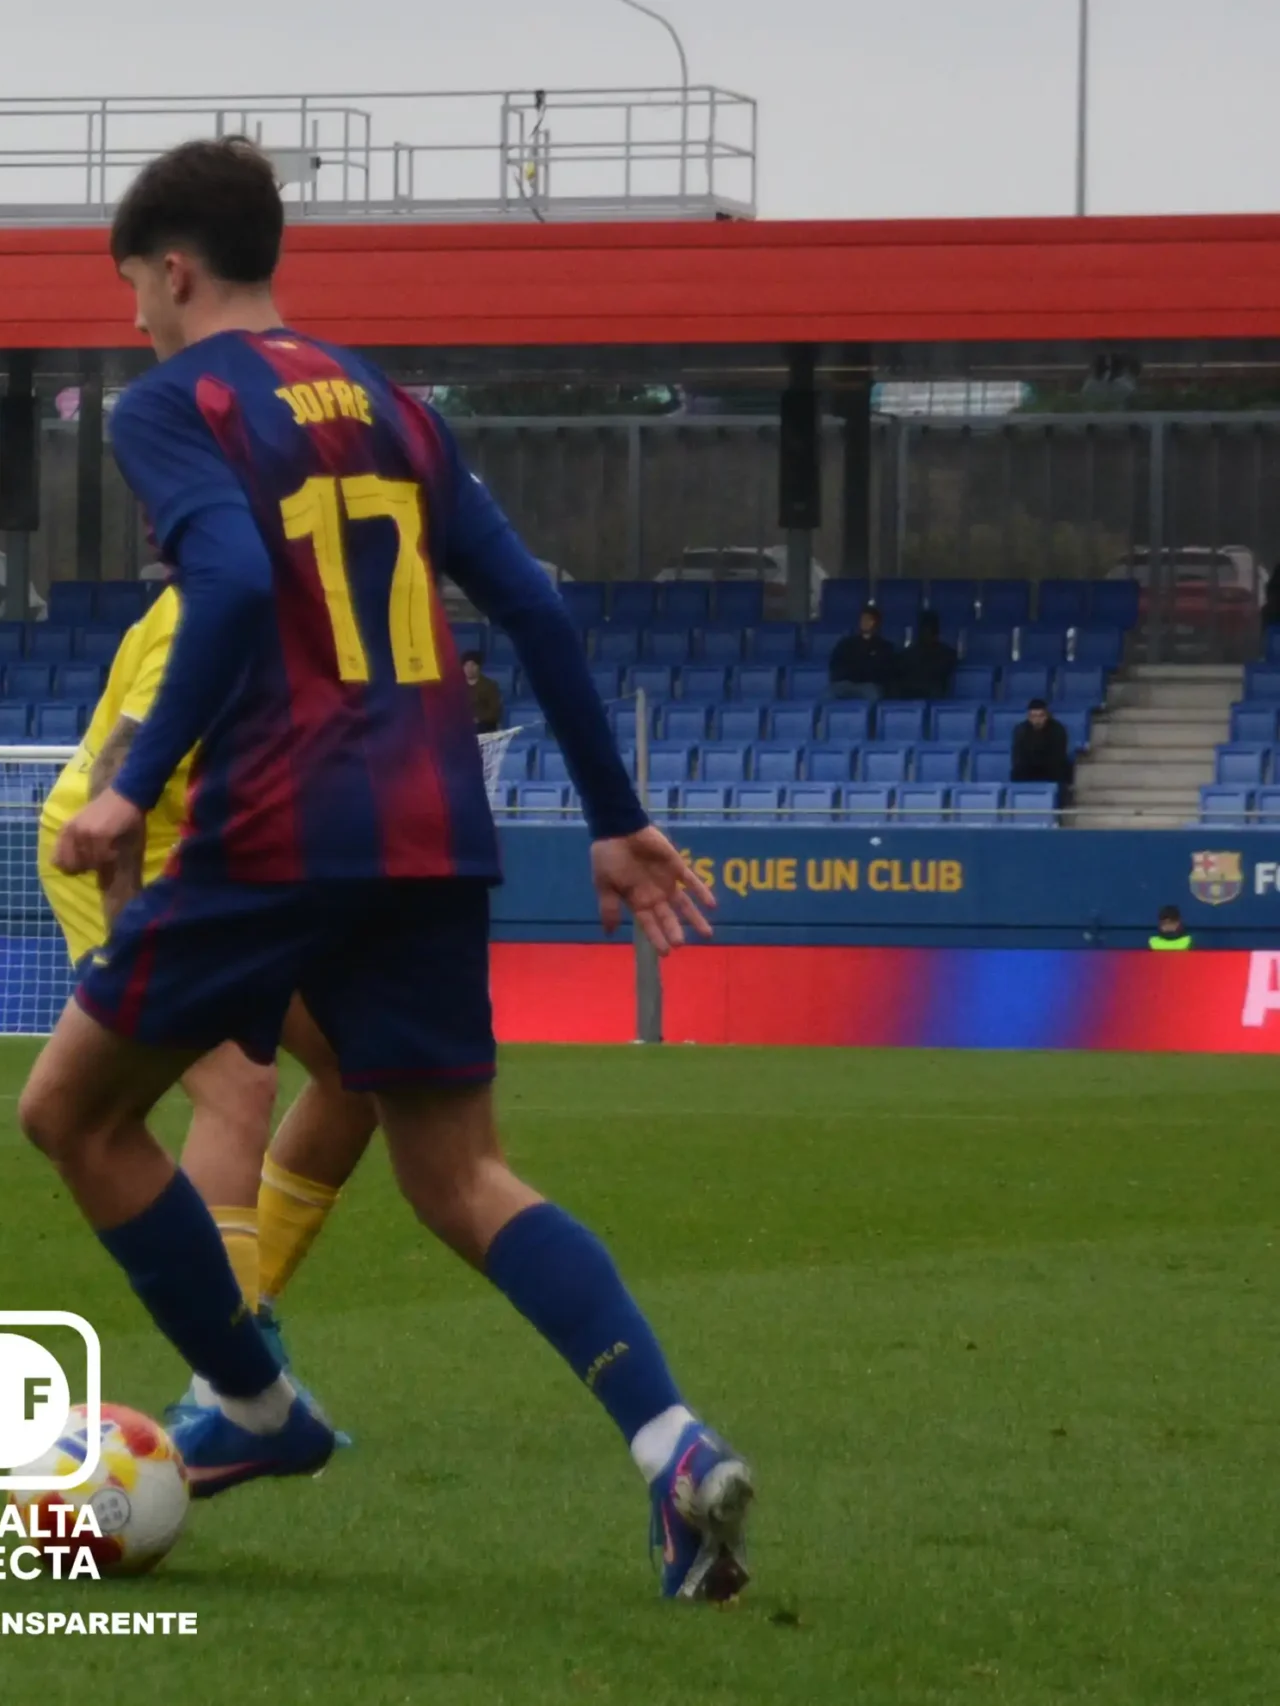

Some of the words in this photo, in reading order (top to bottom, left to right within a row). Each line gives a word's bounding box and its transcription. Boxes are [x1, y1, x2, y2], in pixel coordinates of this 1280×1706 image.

[274, 379, 373, 425] JOFRE
[279, 473, 441, 685] 17
[723, 857, 798, 897] QUE
[807, 858, 859, 891] UN
[867, 858, 963, 892] CLUB
[1254, 862, 1280, 895] F
